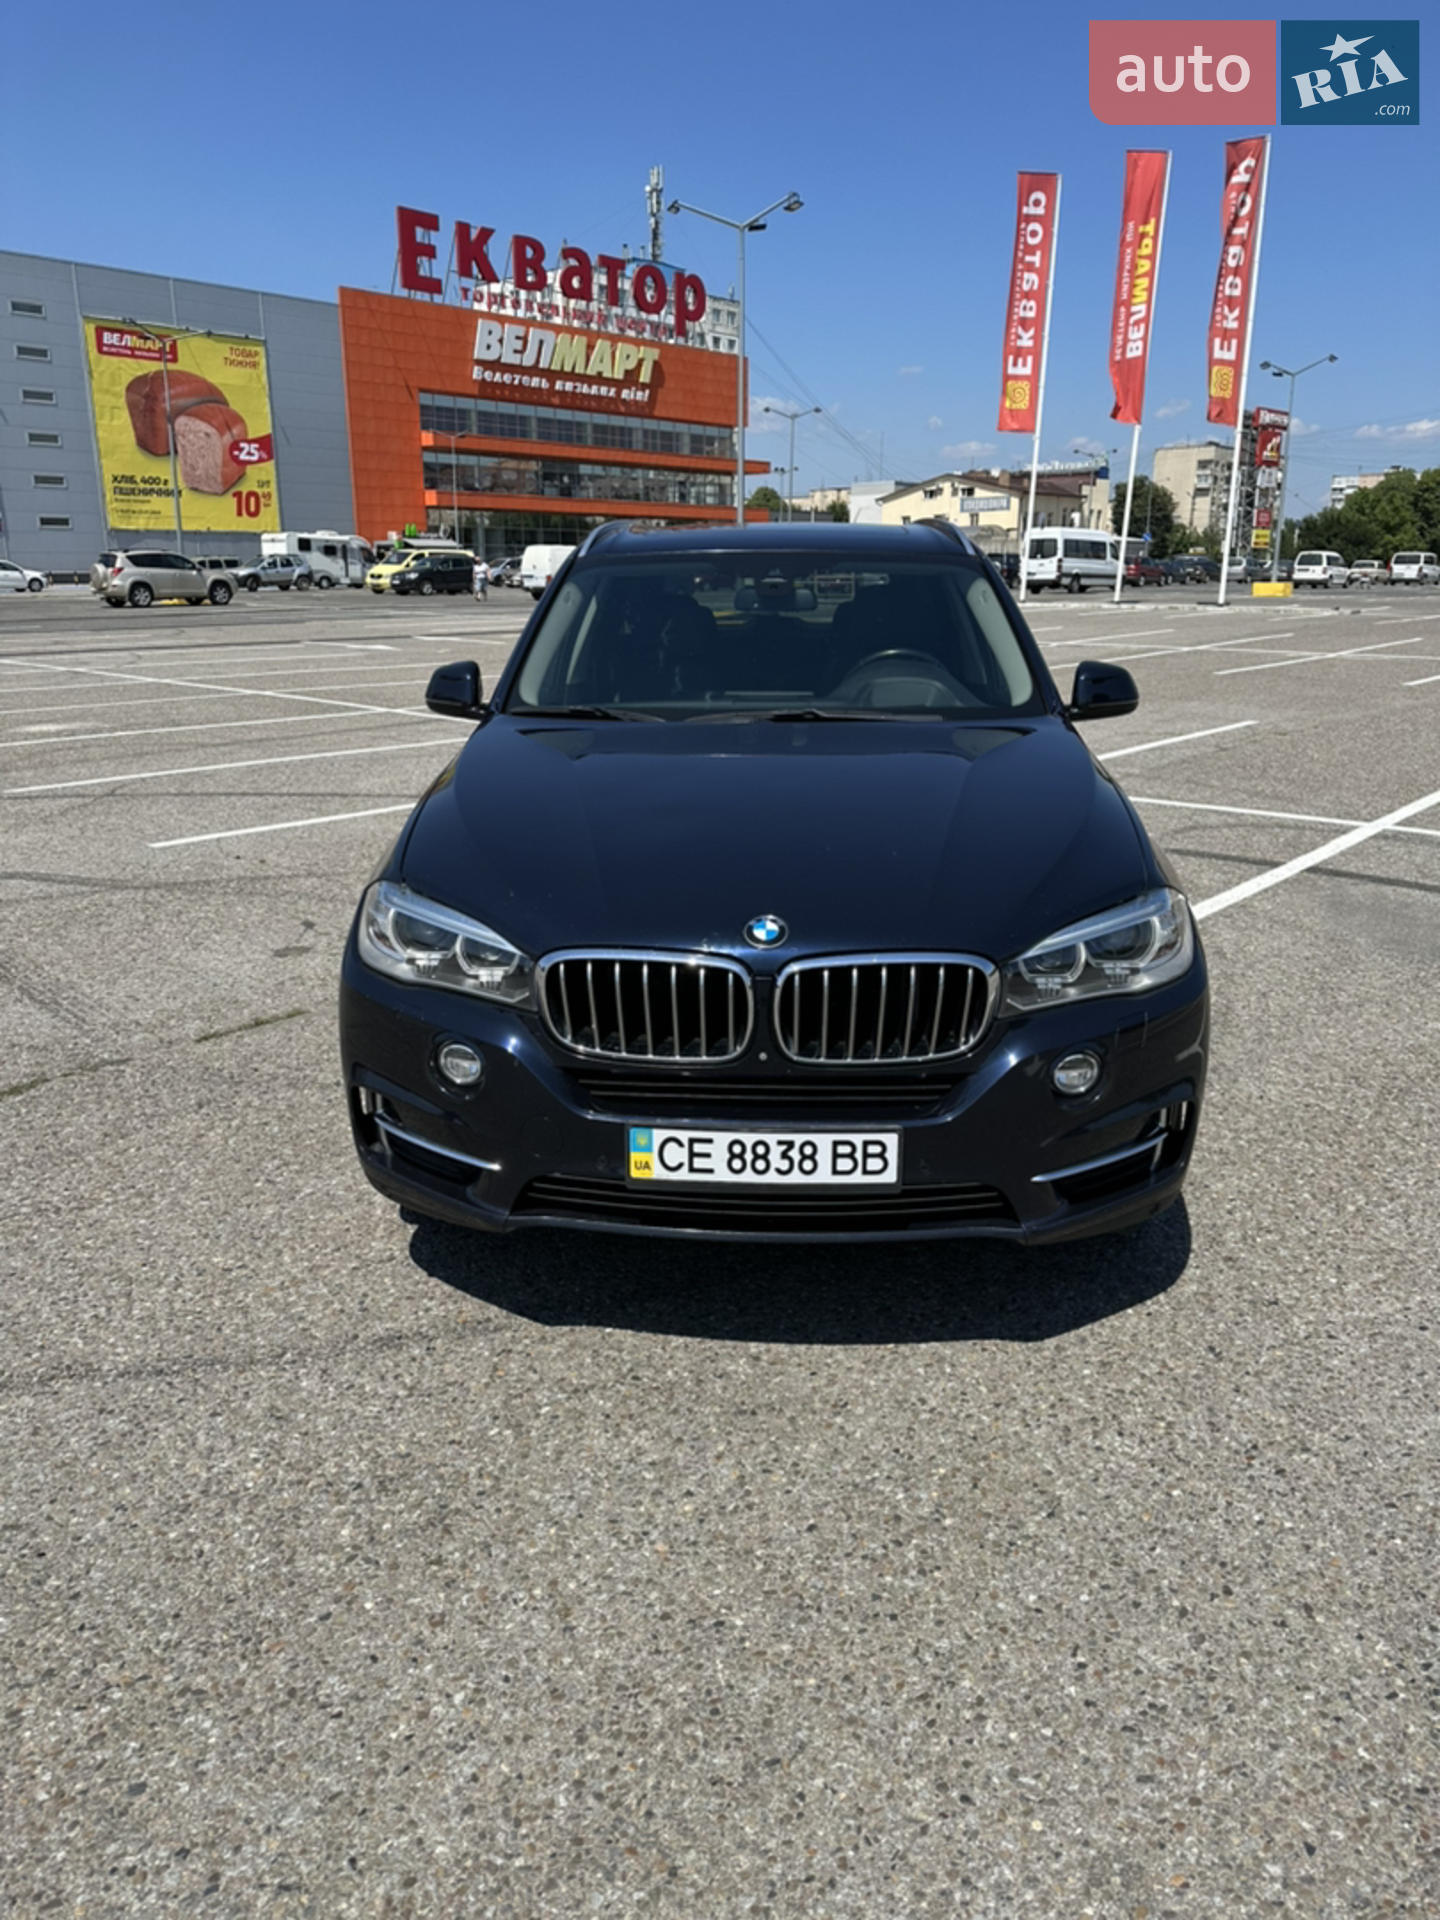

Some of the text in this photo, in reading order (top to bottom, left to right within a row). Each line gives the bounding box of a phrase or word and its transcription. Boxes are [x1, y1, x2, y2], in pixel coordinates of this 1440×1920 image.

[397, 206, 706, 337] Екватор
[228, 346, 260, 360] ТОВАР
[473, 317, 660, 384] ВЕЛМАРТ
[140, 475, 162, 486] 400
[231, 489, 261, 518] 10
[634, 1160, 652, 1172] UA
[657, 1136, 889, 1176] CE 8838 BB
